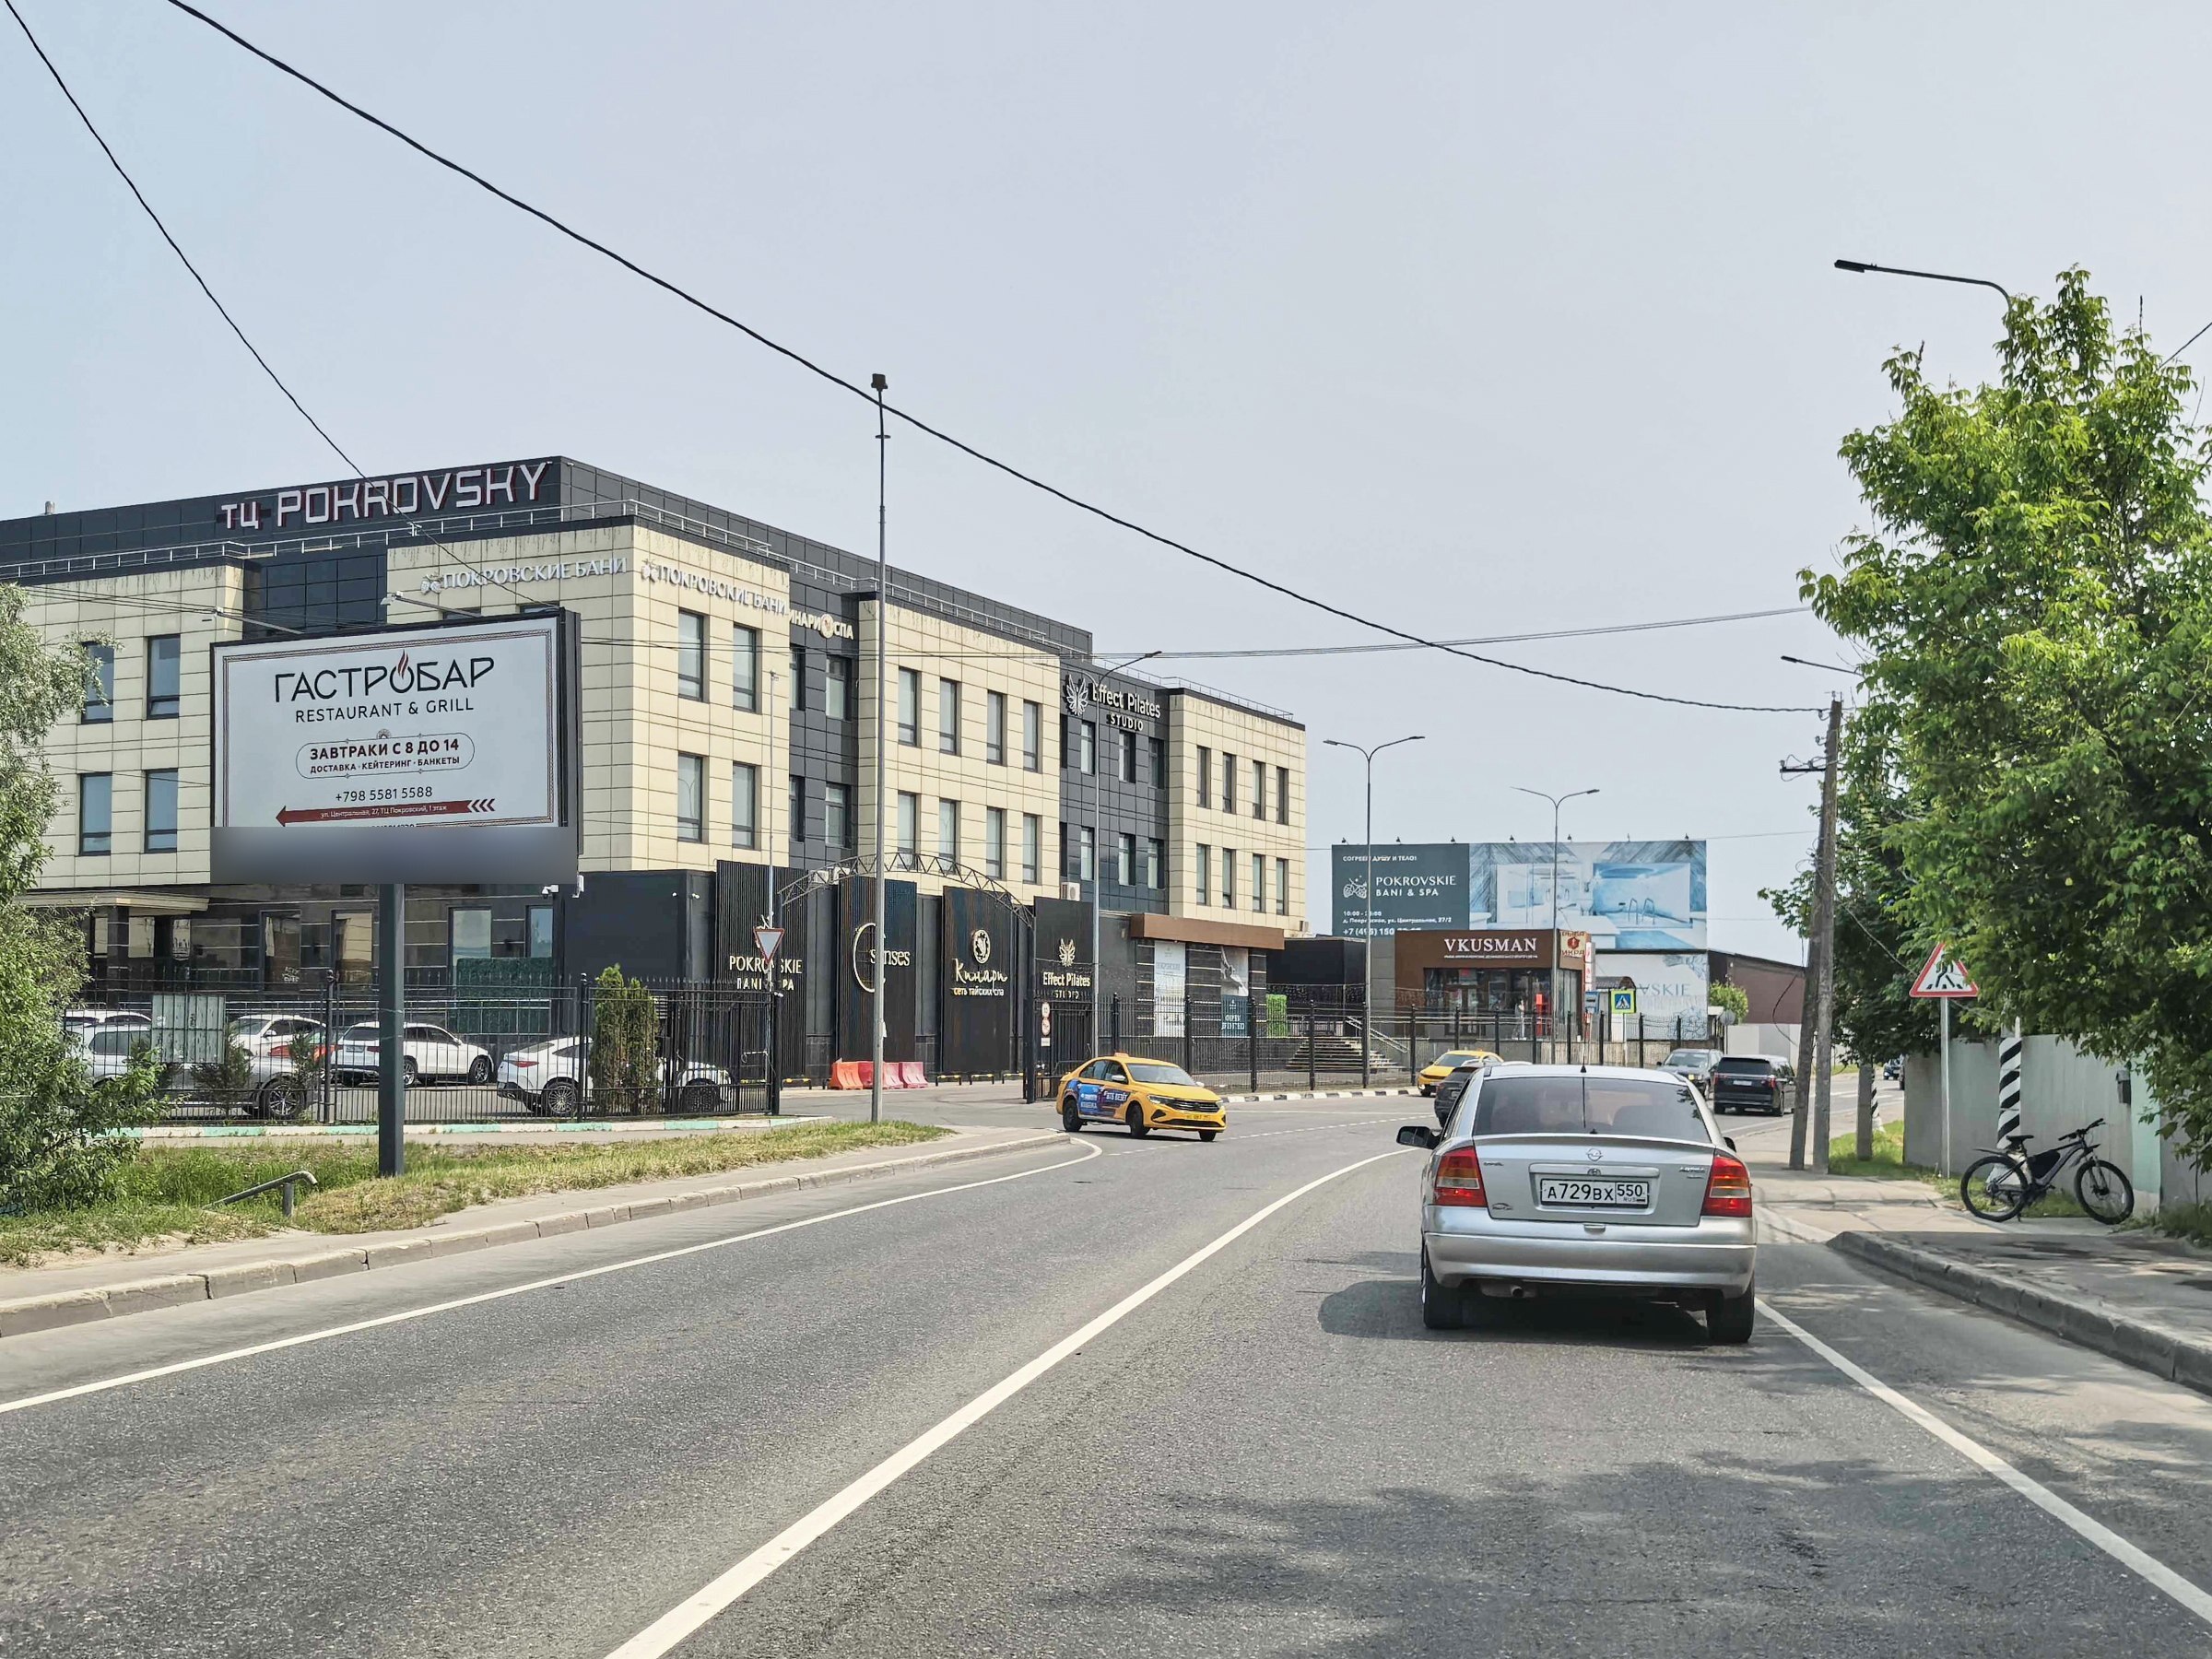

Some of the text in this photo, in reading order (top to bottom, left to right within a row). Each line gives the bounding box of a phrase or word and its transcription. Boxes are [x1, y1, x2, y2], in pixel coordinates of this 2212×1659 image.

[277, 462, 547, 527] POKROVSKY
[443, 558, 628, 589] ПОКРОВСКИЕ БАНИ
[658, 565, 787, 617] ПОКРОВСКИЕ БАНИ
[833, 621, 854, 641] СПА
[275, 656, 495, 703] ГАСТРОБАР
[295, 697, 475, 724] RESTAURANT & GRILL
[1092, 683, 1161, 719] Effect Pilates
[1110, 712, 1144, 732] STUDIO
[310, 738, 460, 760] ЗАВТРАКИ С 8 ДО 14
[310, 757, 460, 775] ДОСТАВКА КЕЙТЕРИНГ БАНКЕТЫ
[335, 786, 433, 803] +798 5581 5588
[1376, 876, 1456, 886] POKROVSKIE
[1443, 938, 1537, 952] VKUSMAN
[869, 948, 911, 966] snses
[1042, 971, 1091, 987] Effect Pilates
[1547, 1182, 1643, 1201] А729ВХ 550
